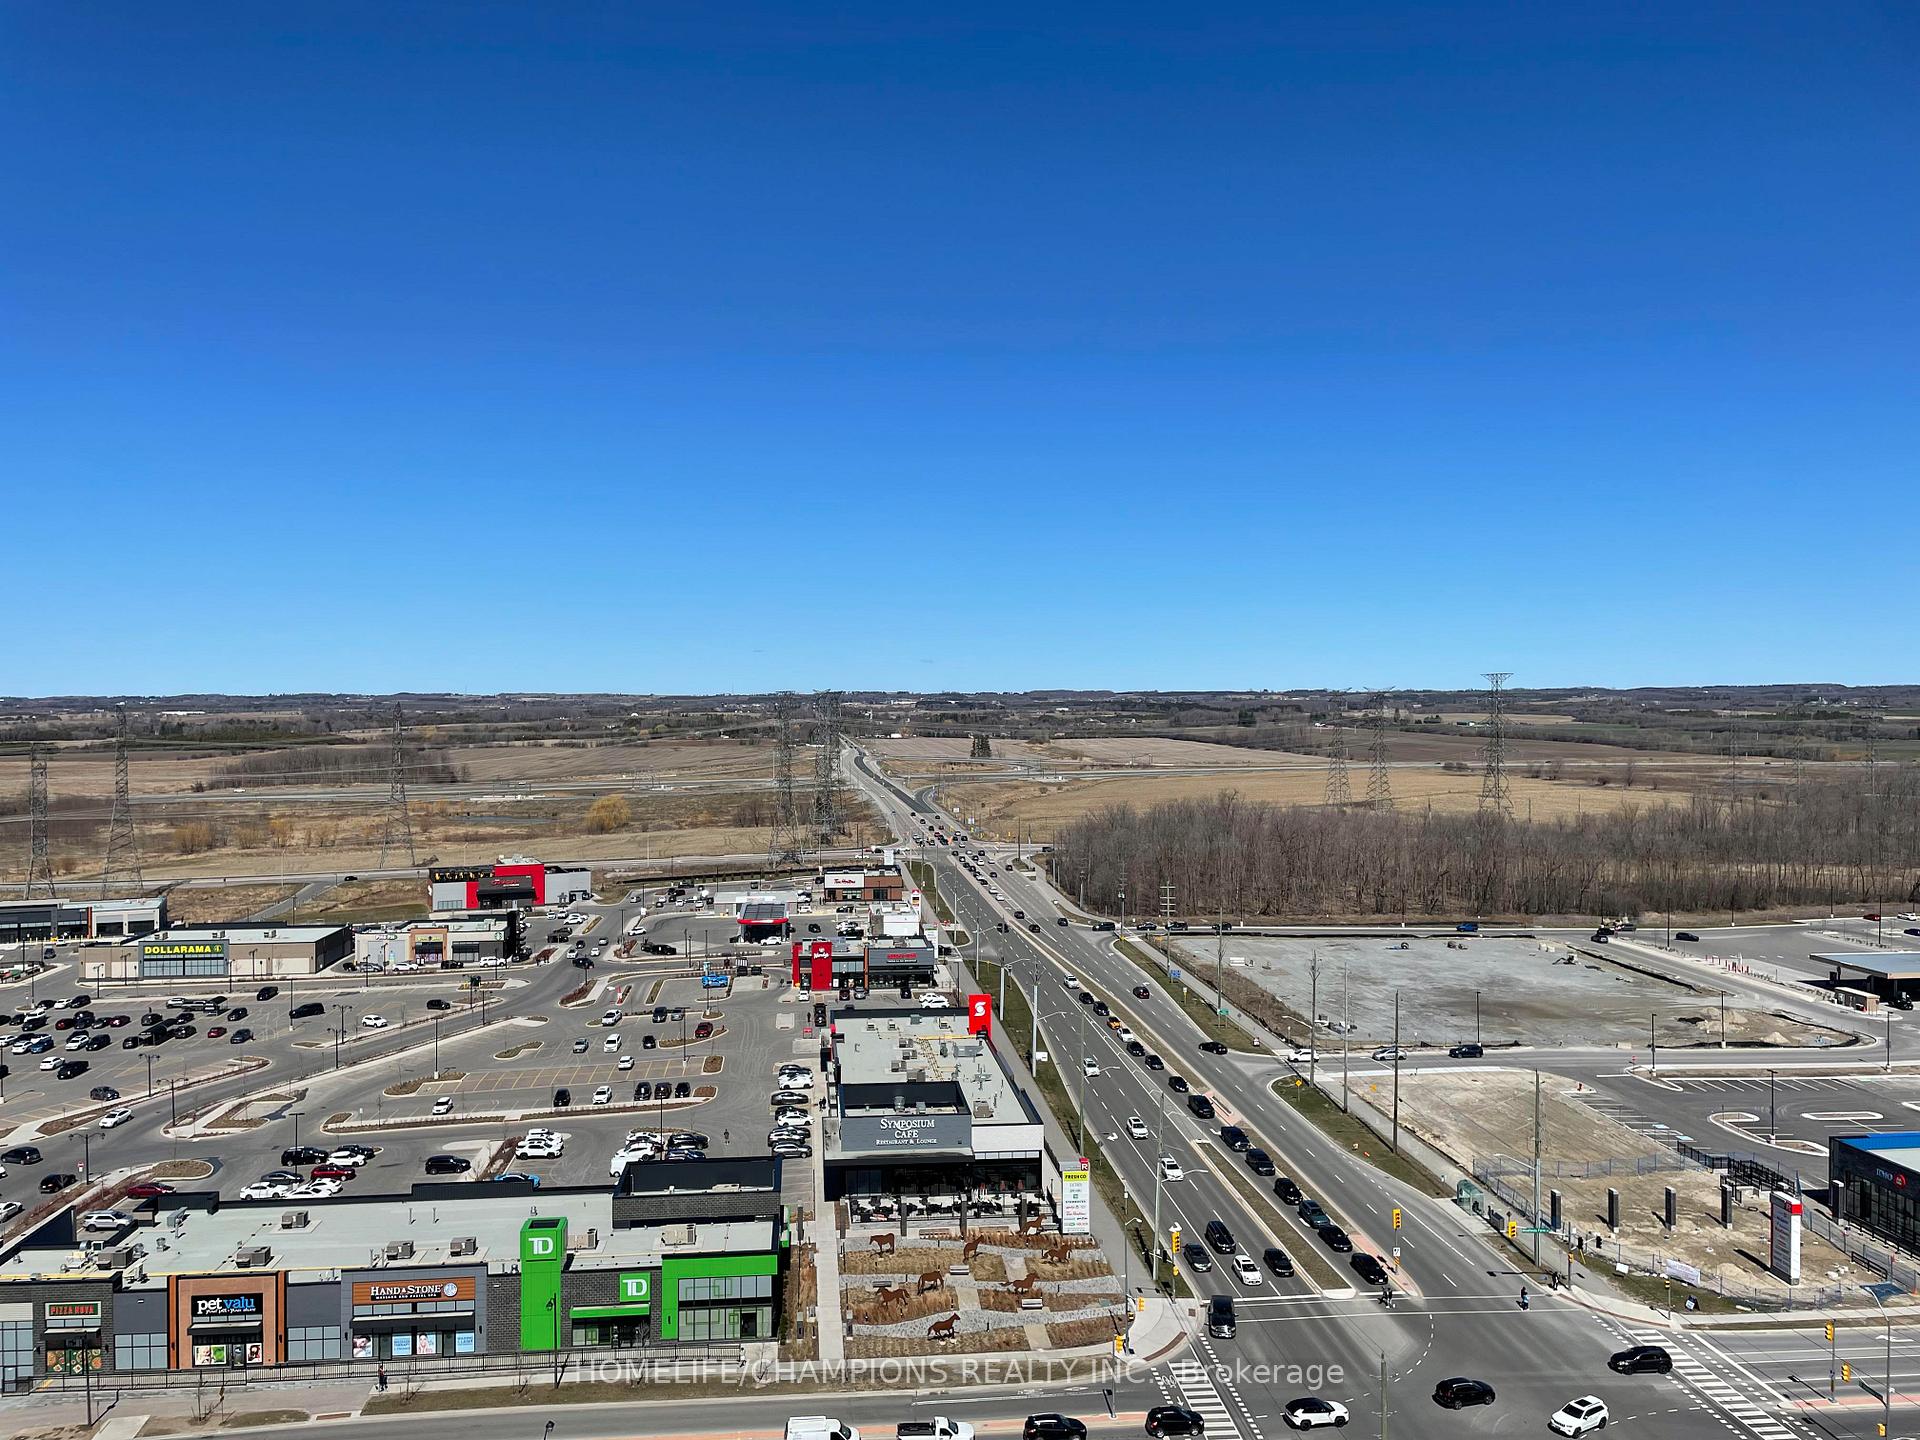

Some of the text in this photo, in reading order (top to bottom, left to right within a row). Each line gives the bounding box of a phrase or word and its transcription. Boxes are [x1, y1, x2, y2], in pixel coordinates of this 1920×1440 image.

[144, 945, 211, 954] DOLLARAMA
[880, 1118, 935, 1130] SYMPOSIUM
[894, 1130, 919, 1139] CAFE
[528, 1236, 554, 1255] TD
[371, 1286, 401, 1296] HAND
[622, 1278, 648, 1297] TD
[50, 1304, 95, 1315] PIZZA NOVA
[196, 1296, 256, 1315] pet valu
